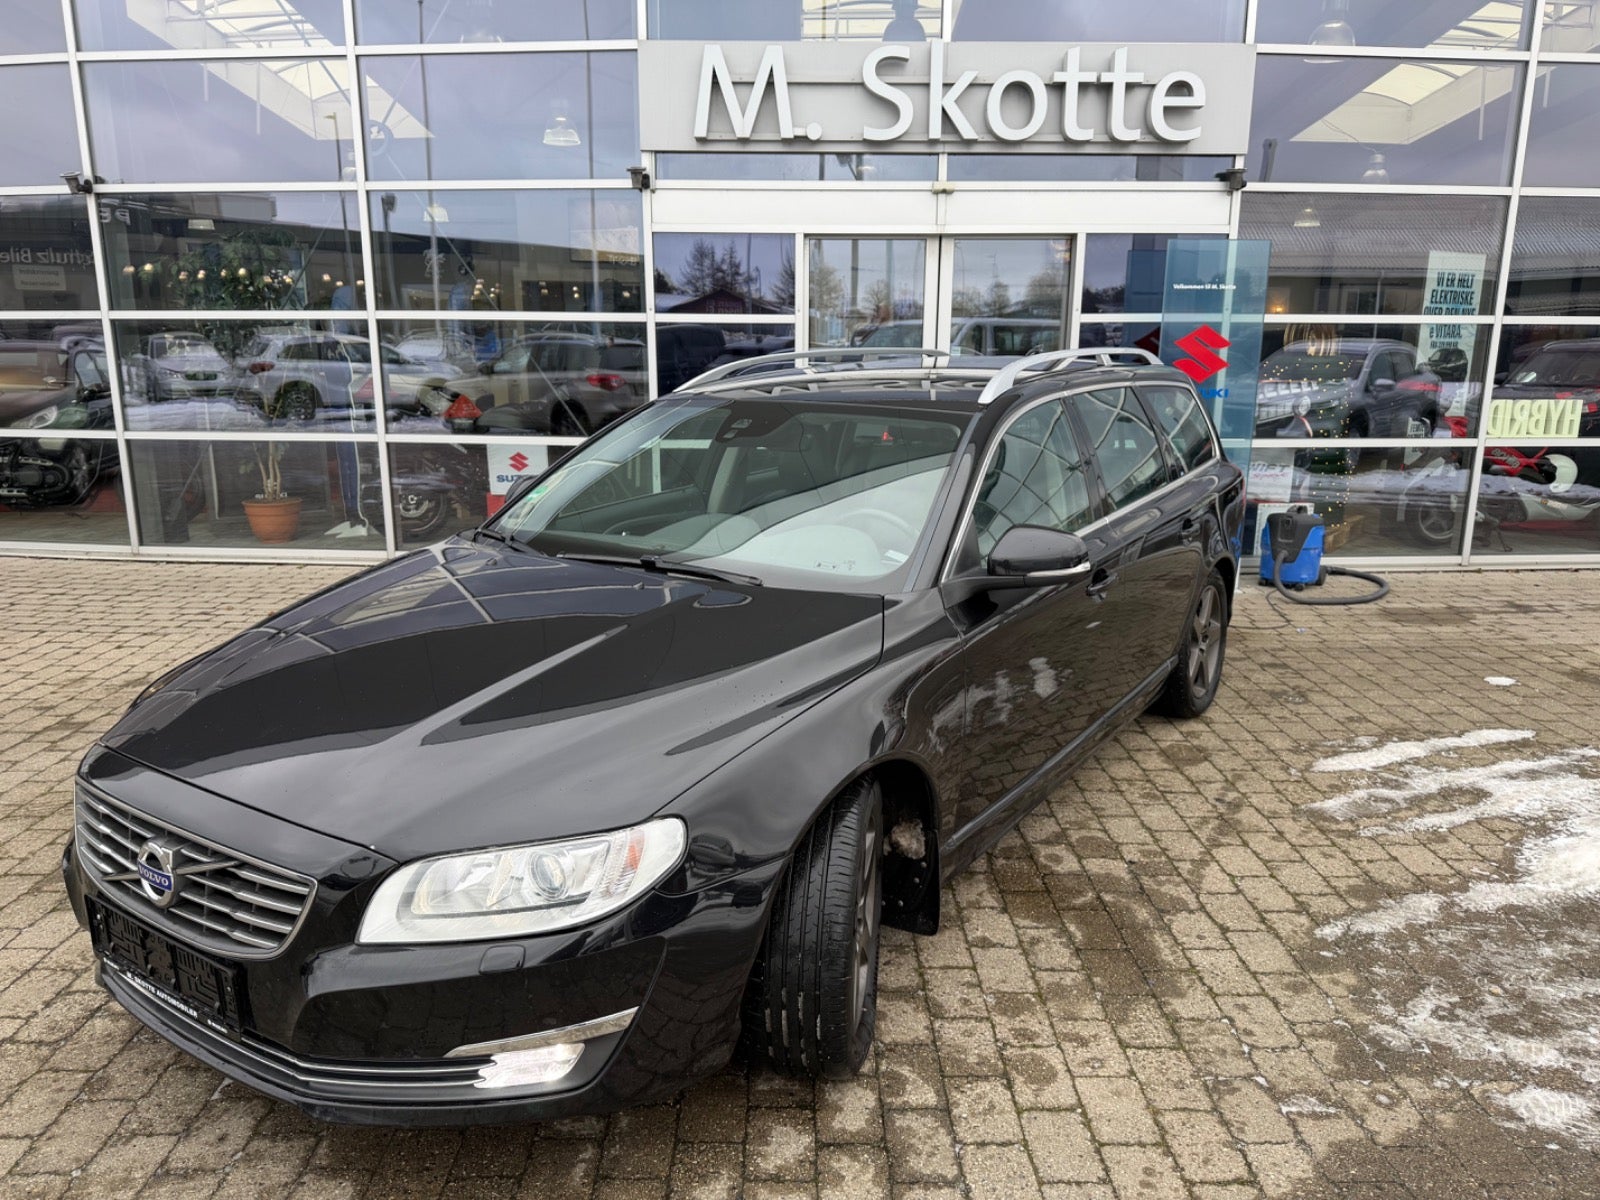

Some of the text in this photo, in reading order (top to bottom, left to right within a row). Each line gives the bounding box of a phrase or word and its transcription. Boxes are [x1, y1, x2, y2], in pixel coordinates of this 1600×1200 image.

[694, 38, 1206, 142] M. Skotte
[1437, 272, 1475, 289] VI ER HELT
[1430, 289, 1475, 306] ELEKTRISKE
[1199, 388, 1229, 398] UKI
[139, 865, 169, 886] VOLVO
[134, 976, 156, 995] SKOTTE
[156, 990, 198, 1019] AUTOMOBILER
